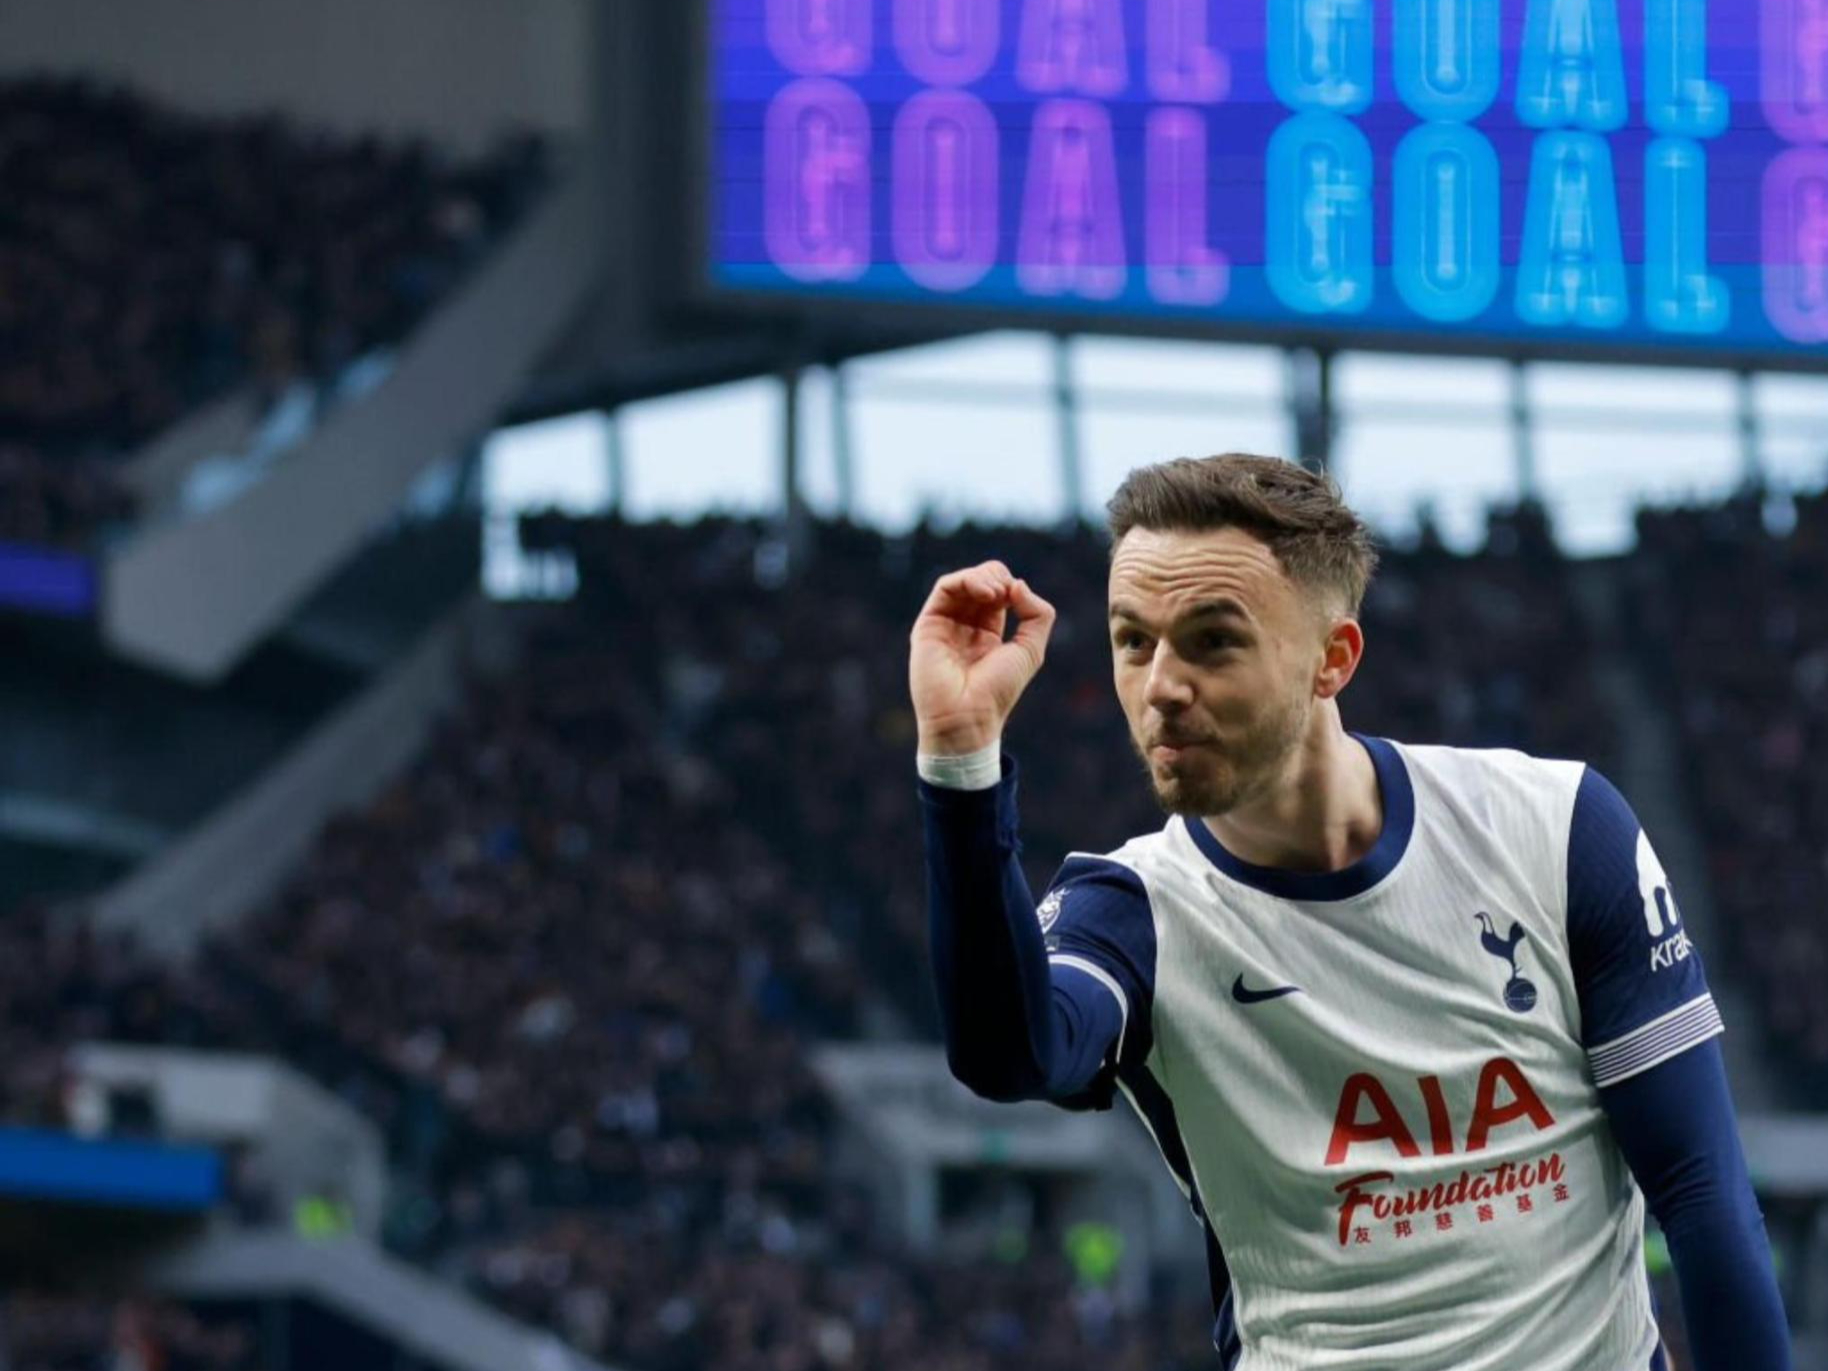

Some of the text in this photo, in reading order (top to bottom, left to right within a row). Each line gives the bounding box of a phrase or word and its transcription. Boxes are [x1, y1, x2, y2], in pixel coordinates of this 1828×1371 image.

[1266, 0, 1730, 139] GOAL
[765, 77, 1230, 306] GOAL
[1266, 110, 1730, 333] GOAL
[1324, 1057, 1556, 1166] AIA
[1335, 1153, 1566, 1246] Foundation
